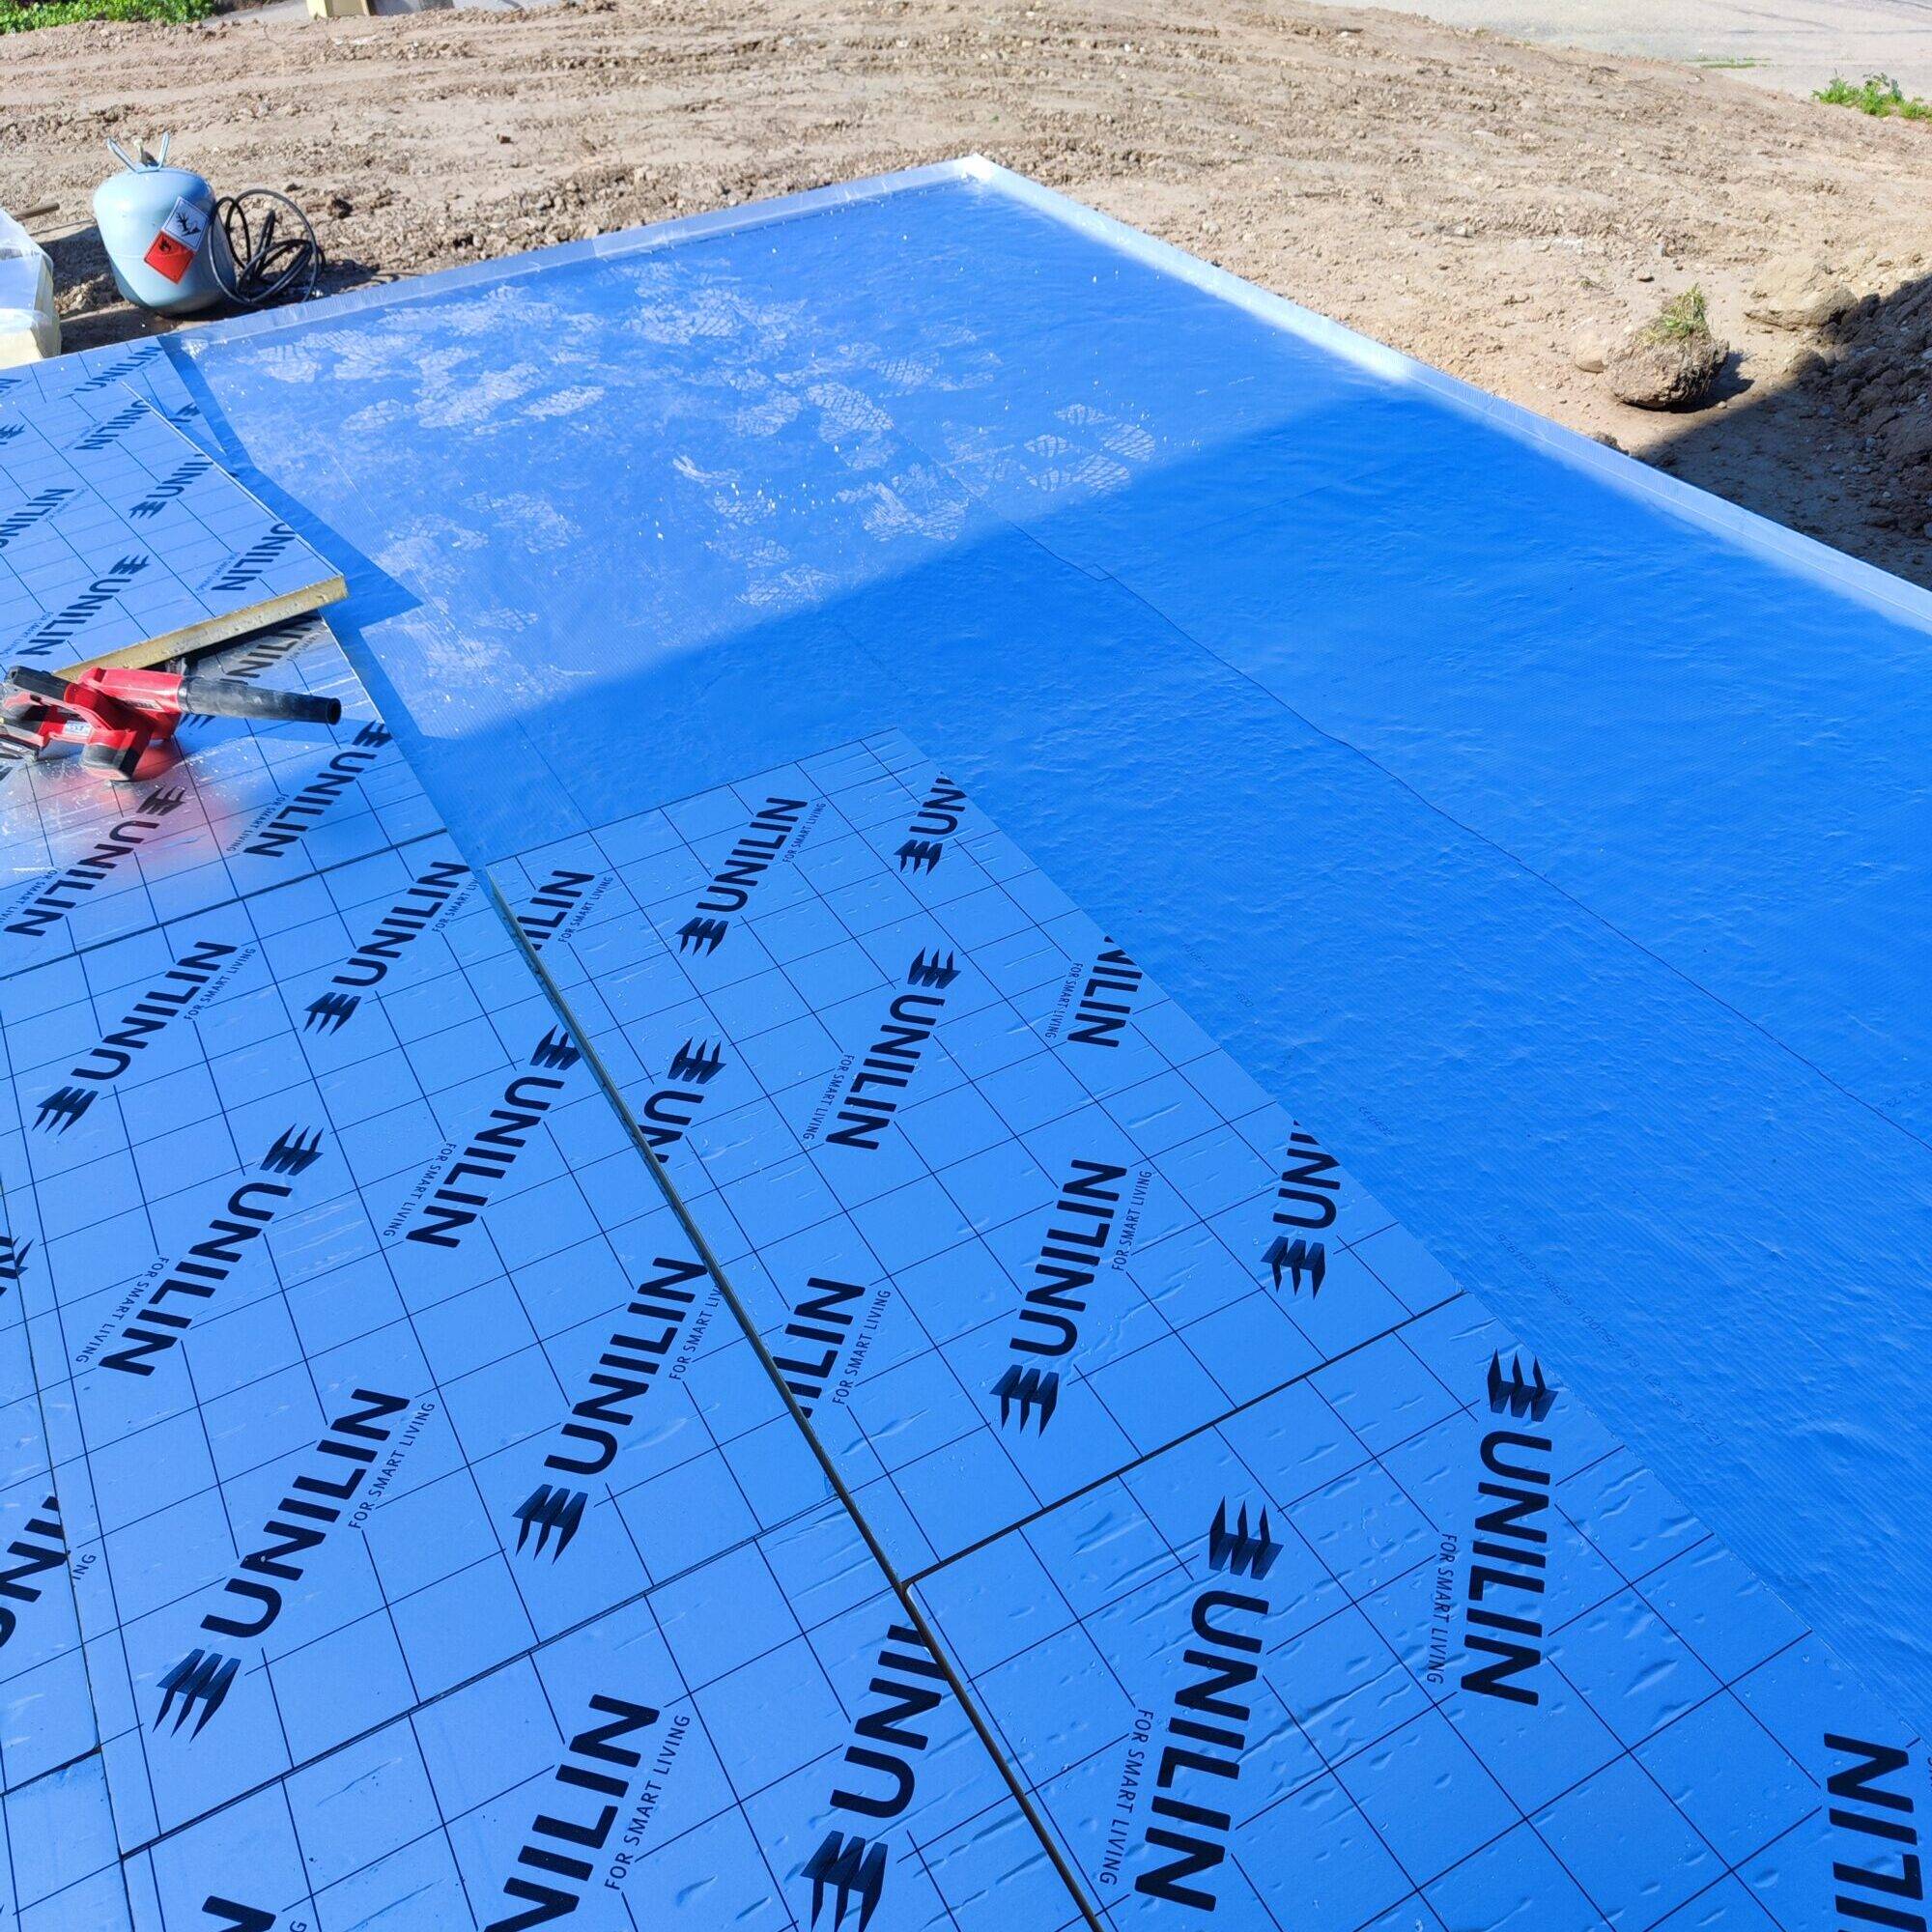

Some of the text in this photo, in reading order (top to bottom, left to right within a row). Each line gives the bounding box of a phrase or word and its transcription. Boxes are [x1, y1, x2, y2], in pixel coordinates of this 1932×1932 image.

[16, 579, 131, 656] UNILIN
[226, 828, 254, 852] LIVING
[243, 752, 377, 858] UNILIN
[255, 807, 277, 829] SMART
[696, 798, 808, 912] UNILIN
[782, 802, 827, 863] FOR SMART LIVING
[4, 820, 160, 937] UNILIN
[20, 881, 45, 905] SMART
[331, 862, 470, 986] UNILIN
[432, 919, 449, 933] FOR
[448, 892, 471, 918] SMART
[558, 875, 613, 943] FOR SMART LIVING
[71, 942, 238, 1081] UNILIN
[184, 947, 256, 1021] FOR SMART LIVING
[1044, 962, 1084, 1039] FOR SMART LIVING
[803, 1054, 855, 1141] FOR SMART LIVING
[825, 994, 946, 1150] UNILIN
[383, 1143, 457, 1237] FOR SMART LIVING
[406, 1076, 565, 1249] UNILIN
[1009, 1159, 1127, 1357] UNILIN
[1112, 1170, 1152, 1271] FOR SMART LIVING
[75, 1257, 169, 1364] FOR SMART LIVING
[98, 1182, 293, 1377] UNILIN
[544, 1257, 708, 1474] UNILIN
[668, 1355, 692, 1380] FOR
[682, 1310, 713, 1353] SMART
[832, 1290, 891, 1405] FOR SMART LIVING
[200, 1388, 411, 1638] UNILIN
[348, 1402, 436, 1529] FOR SMART LIVING
[1426, 1532, 1458, 1686] FOR SMART LIVING
[1461, 1430, 1552, 1707] UNILIN
[604, 1715, 691, 1890] FOR SMART LIVING
[1098, 1708, 1154, 1887] FOR SMART LIVING
[1134, 1590, 1270, 1913] UNILIN
